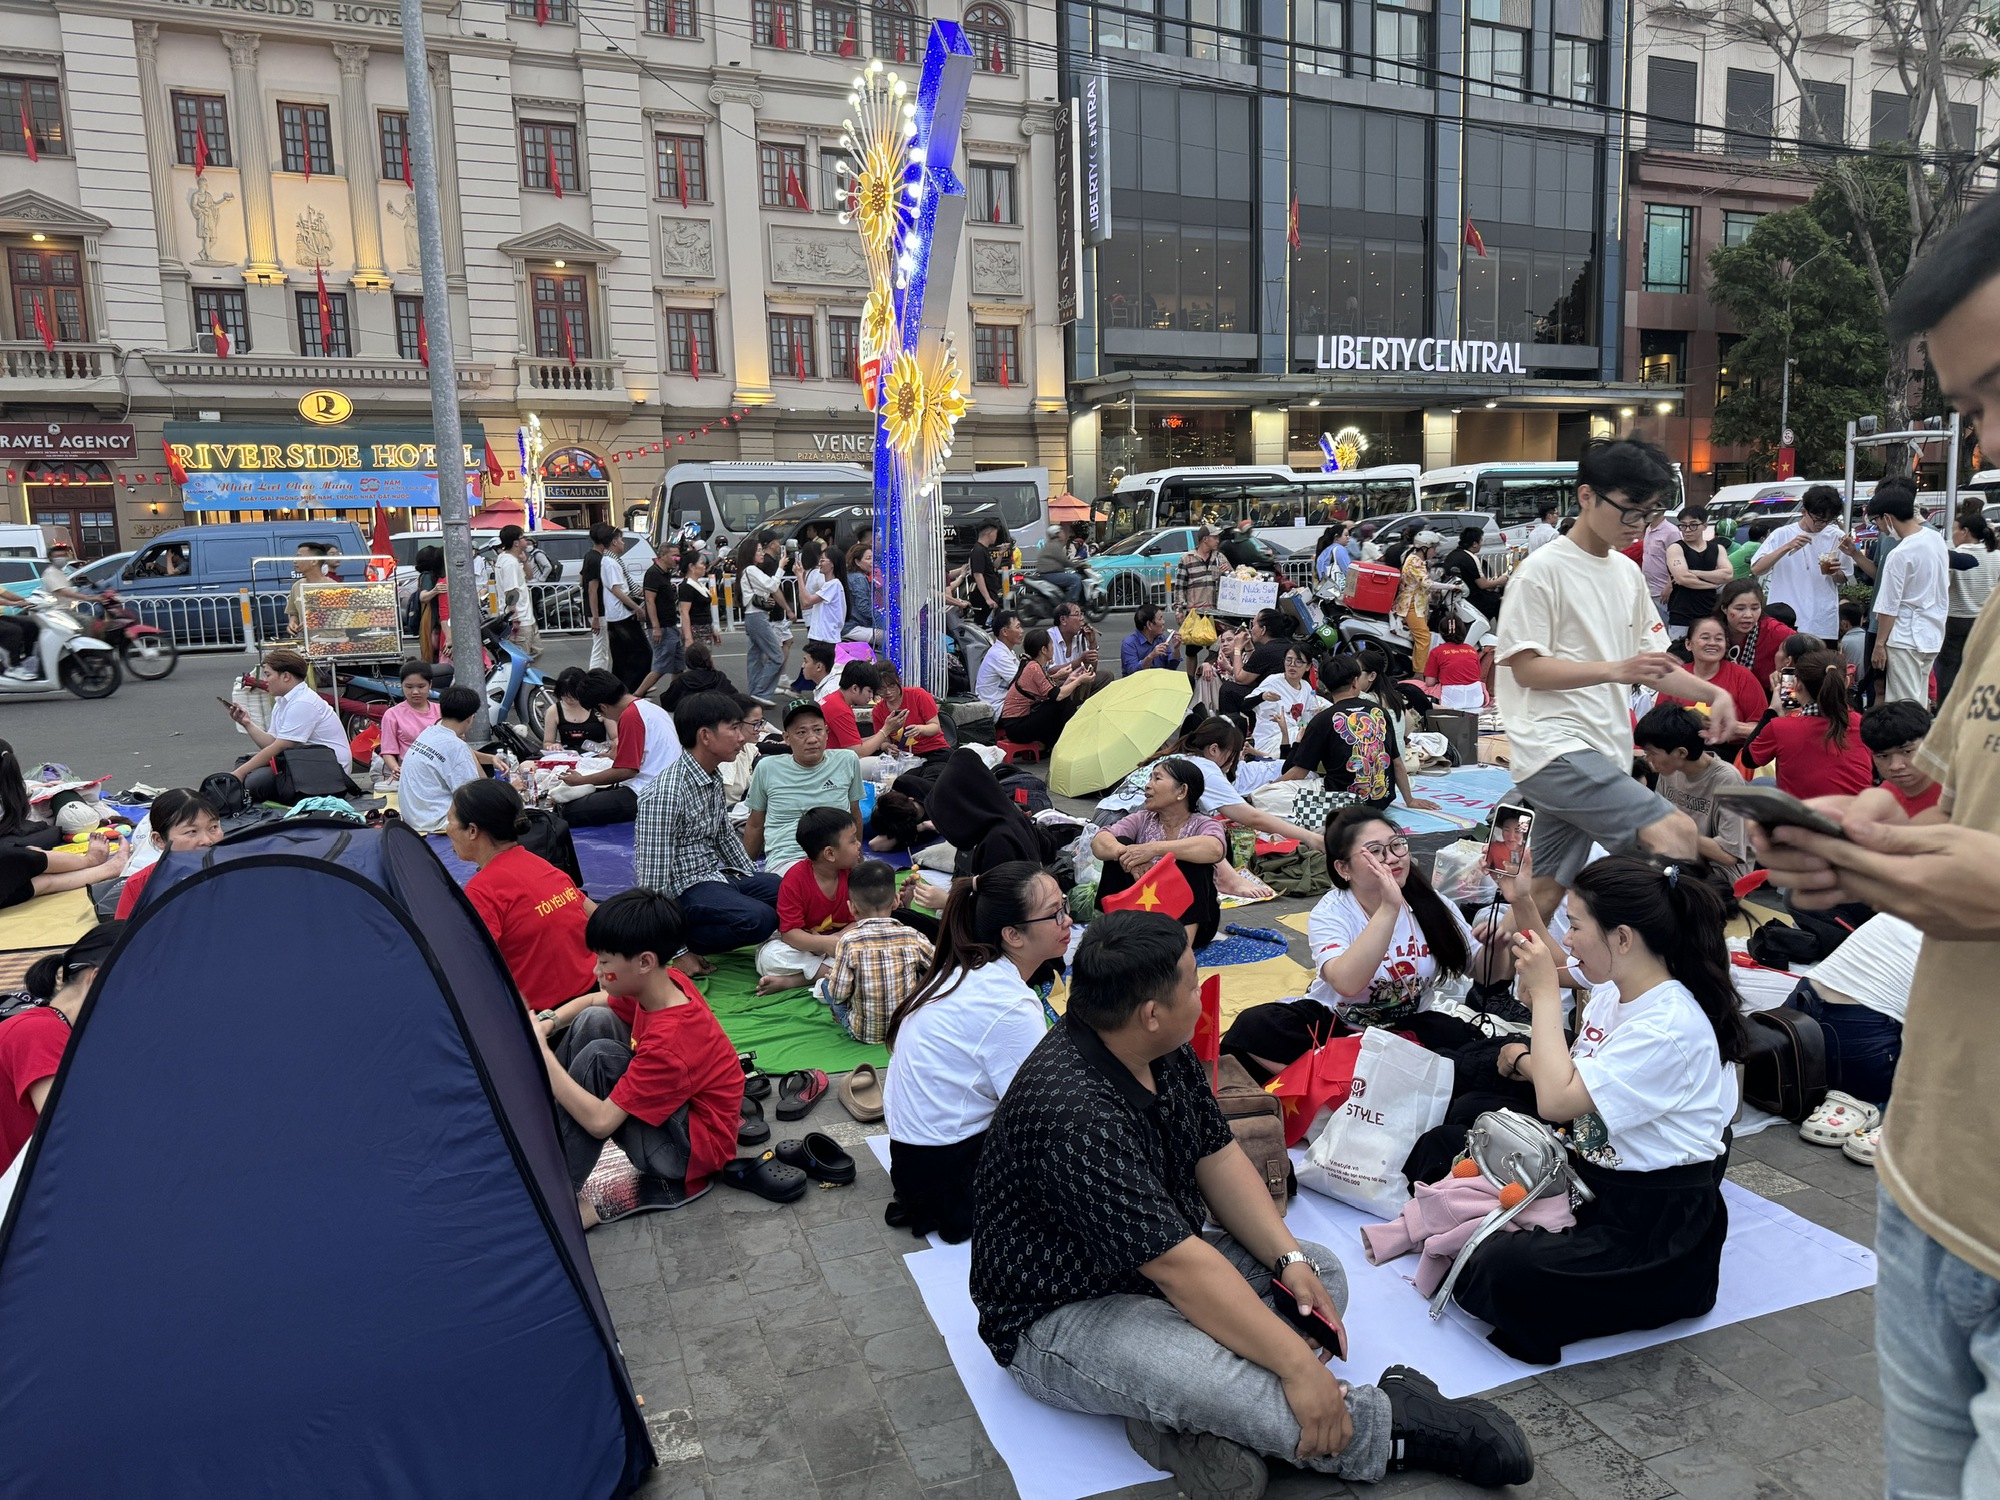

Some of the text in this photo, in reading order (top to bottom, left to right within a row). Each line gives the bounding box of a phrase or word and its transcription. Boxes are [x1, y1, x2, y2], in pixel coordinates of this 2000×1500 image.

[333, 3, 402, 26] HOTE
[1086, 75, 1099, 231] LIBERTY CENTRAL
[1054, 107, 1069, 290] Riverside
[1317, 335, 1527, 374] LIBERTY CENTRAL
[0, 435, 131, 449] RAVEL AGENCY
[812, 434, 876, 452] VENEZ
[171, 443, 481, 469] RIVERSIDE HOTL
[857, 453, 873, 461] STE
[547, 486, 606, 496] RESTAURANT
[1967, 684, 2000, 721] ESS
[534, 900, 554, 917] TÔI
[549, 894, 567, 909] YÊU
[1346, 1103, 1384, 1126] STYLE
